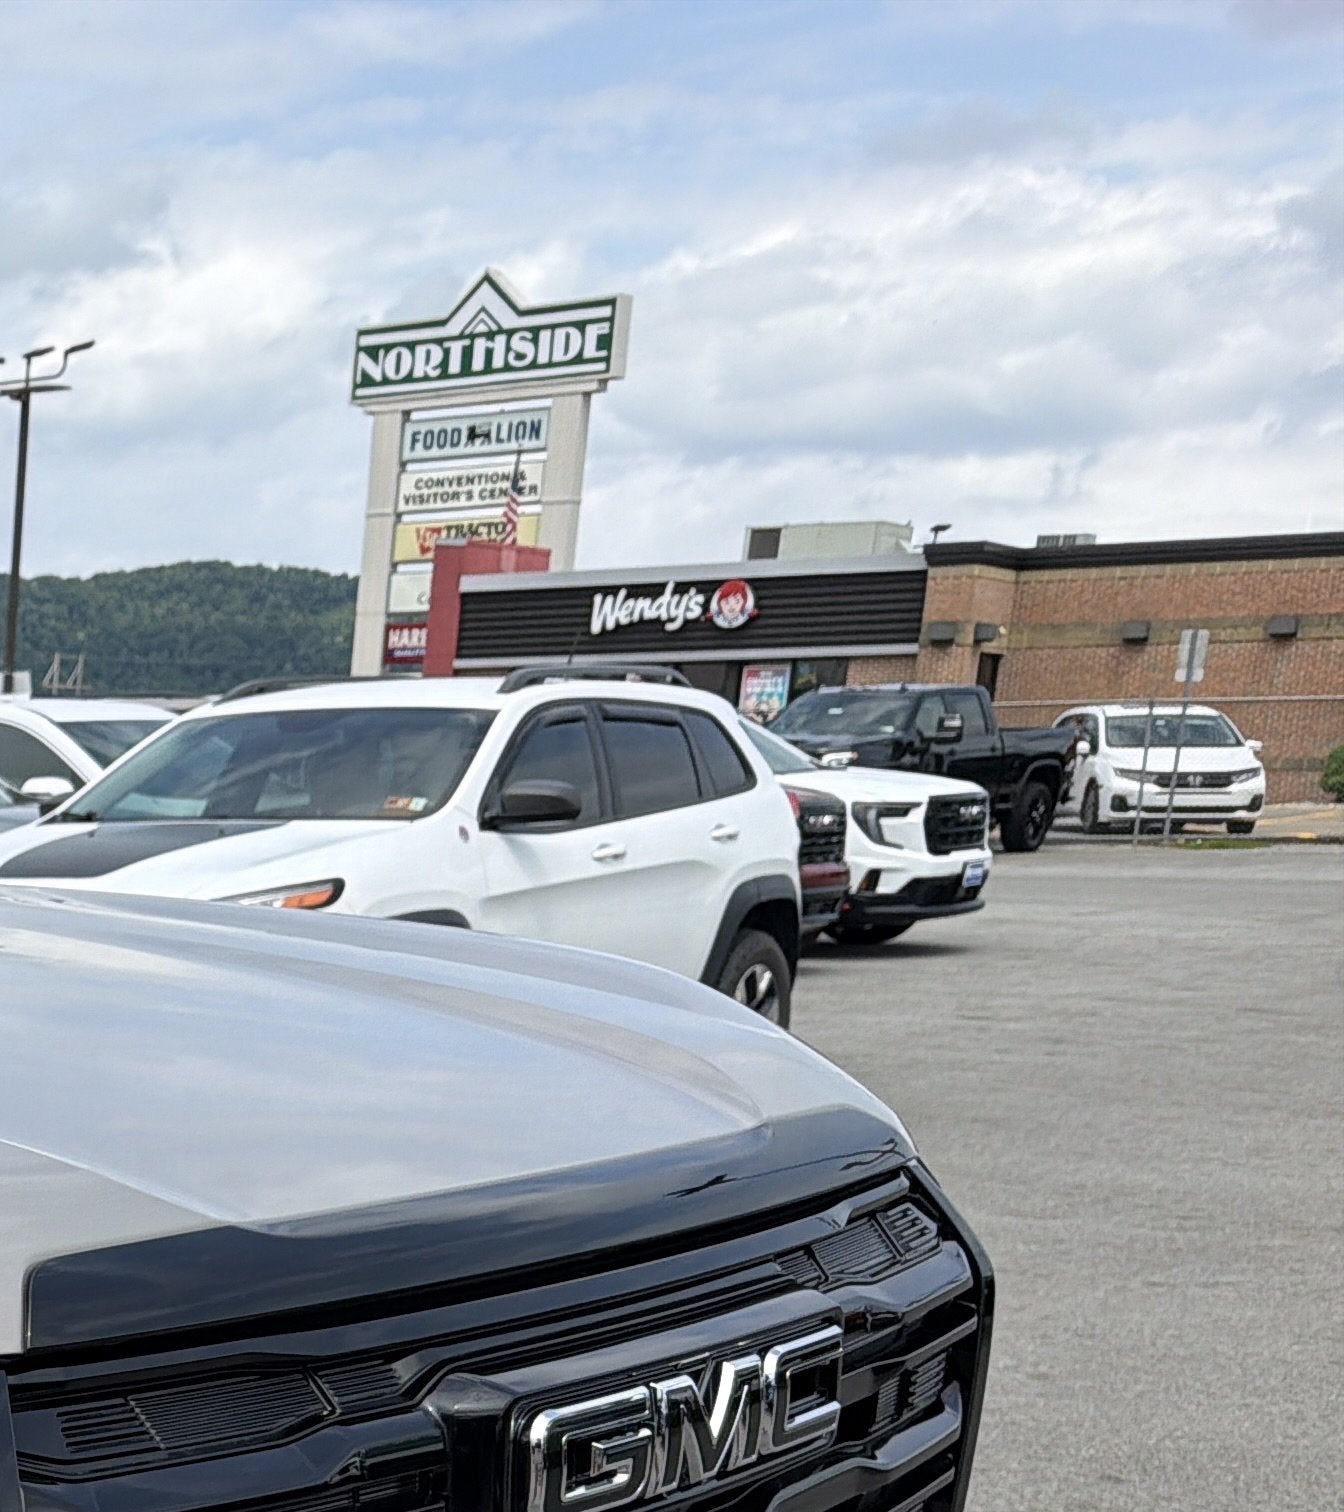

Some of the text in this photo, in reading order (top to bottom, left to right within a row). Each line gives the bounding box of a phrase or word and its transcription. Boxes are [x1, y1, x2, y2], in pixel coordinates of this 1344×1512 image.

[355, 320, 612, 386] NORTHSIDE
[409, 419, 543, 452] FOOD LION
[402, 483, 540, 506] VISITOR'S CENER
[413, 471, 511, 491] CONVENTION
[443, 520, 516, 539] TRACTO
[589, 579, 705, 636] Wendy's
